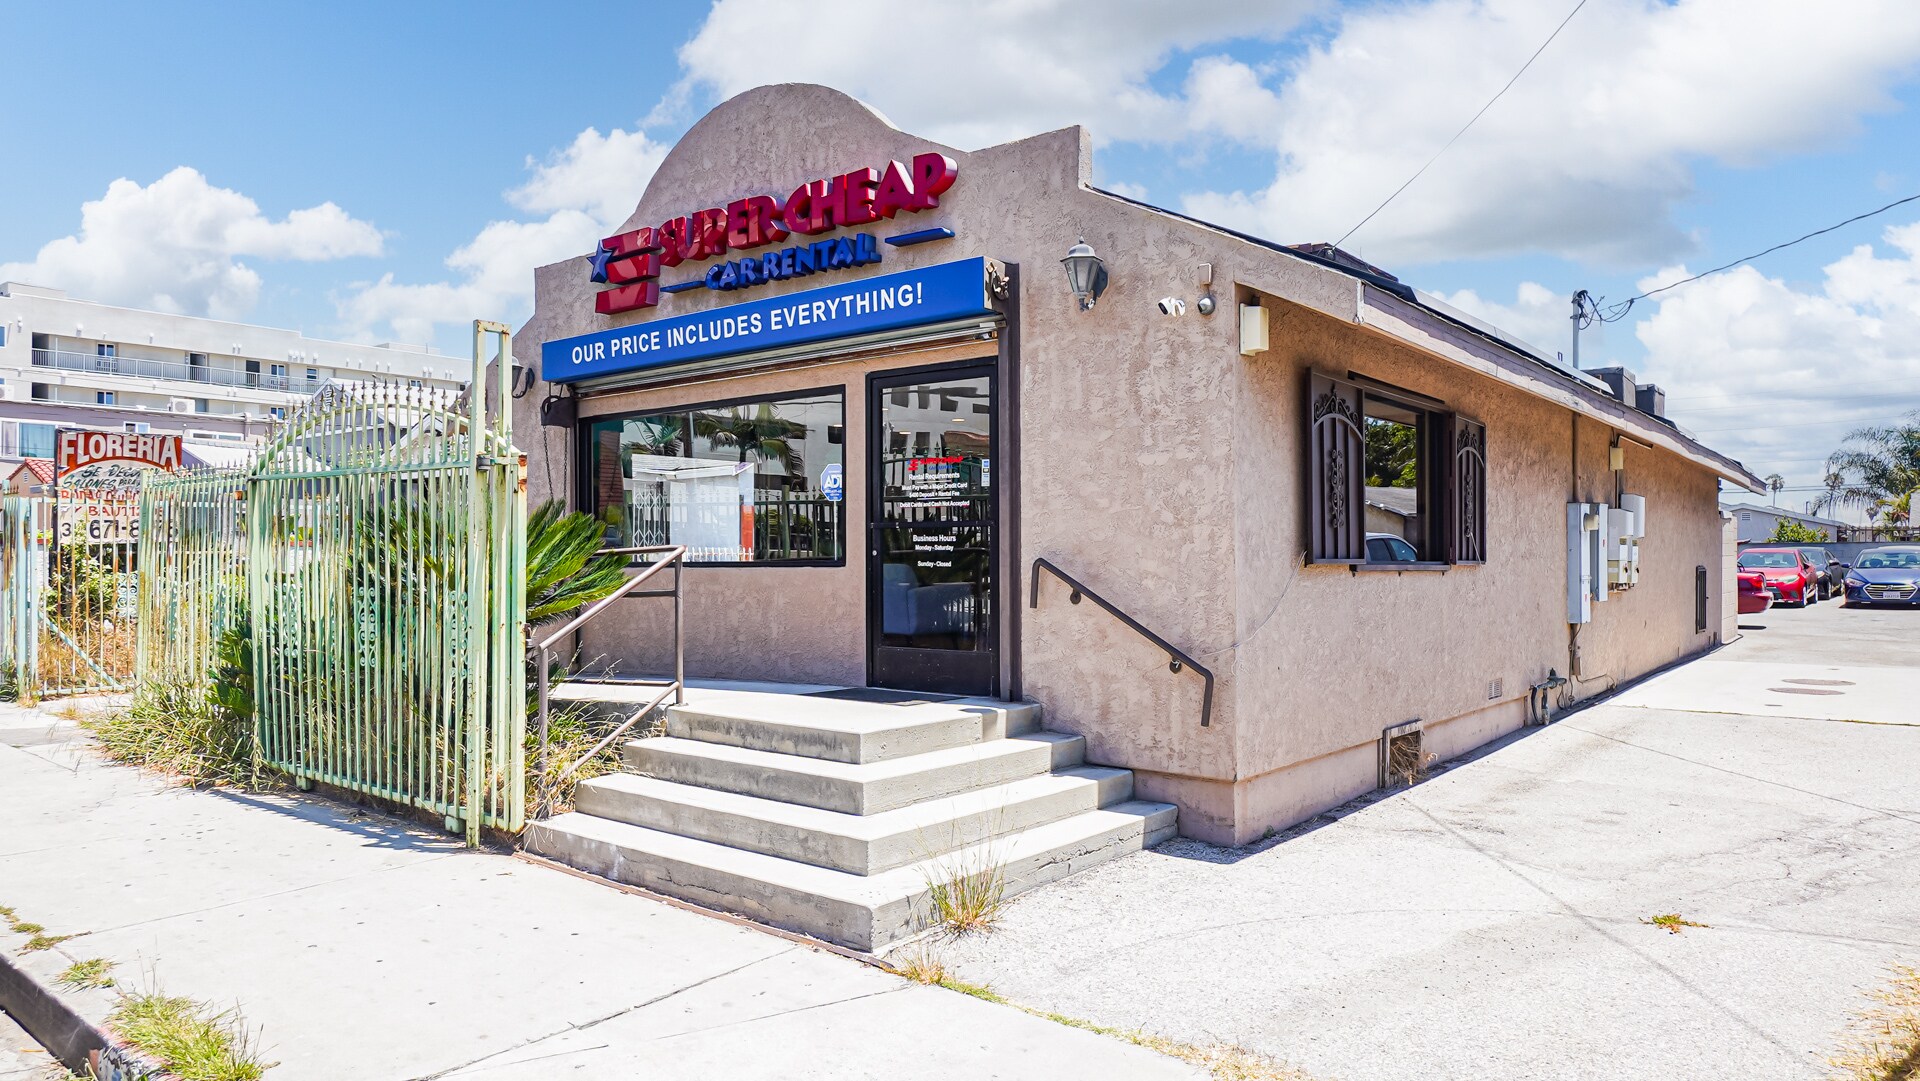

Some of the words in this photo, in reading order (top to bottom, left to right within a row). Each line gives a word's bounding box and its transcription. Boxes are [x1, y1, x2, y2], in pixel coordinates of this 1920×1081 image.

[657, 194, 790, 267] SUPER
[783, 152, 958, 235] CHEAP
[705, 257, 768, 291] CAR
[763, 233, 882, 280] RENTAL
[571, 342, 606, 365] OUR
[611, 331, 661, 358] PRICE
[667, 312, 763, 347] INCLUDES
[770, 282, 923, 331] EVERYTHING!
[60, 433, 180, 476] FLORERIA
[61, 474, 116, 489] SALONES
[81, 464, 102, 478] SE
[925, 472, 960, 480] Requirements
[913, 534, 939, 542] Business
[939, 534, 957, 542] Hours
